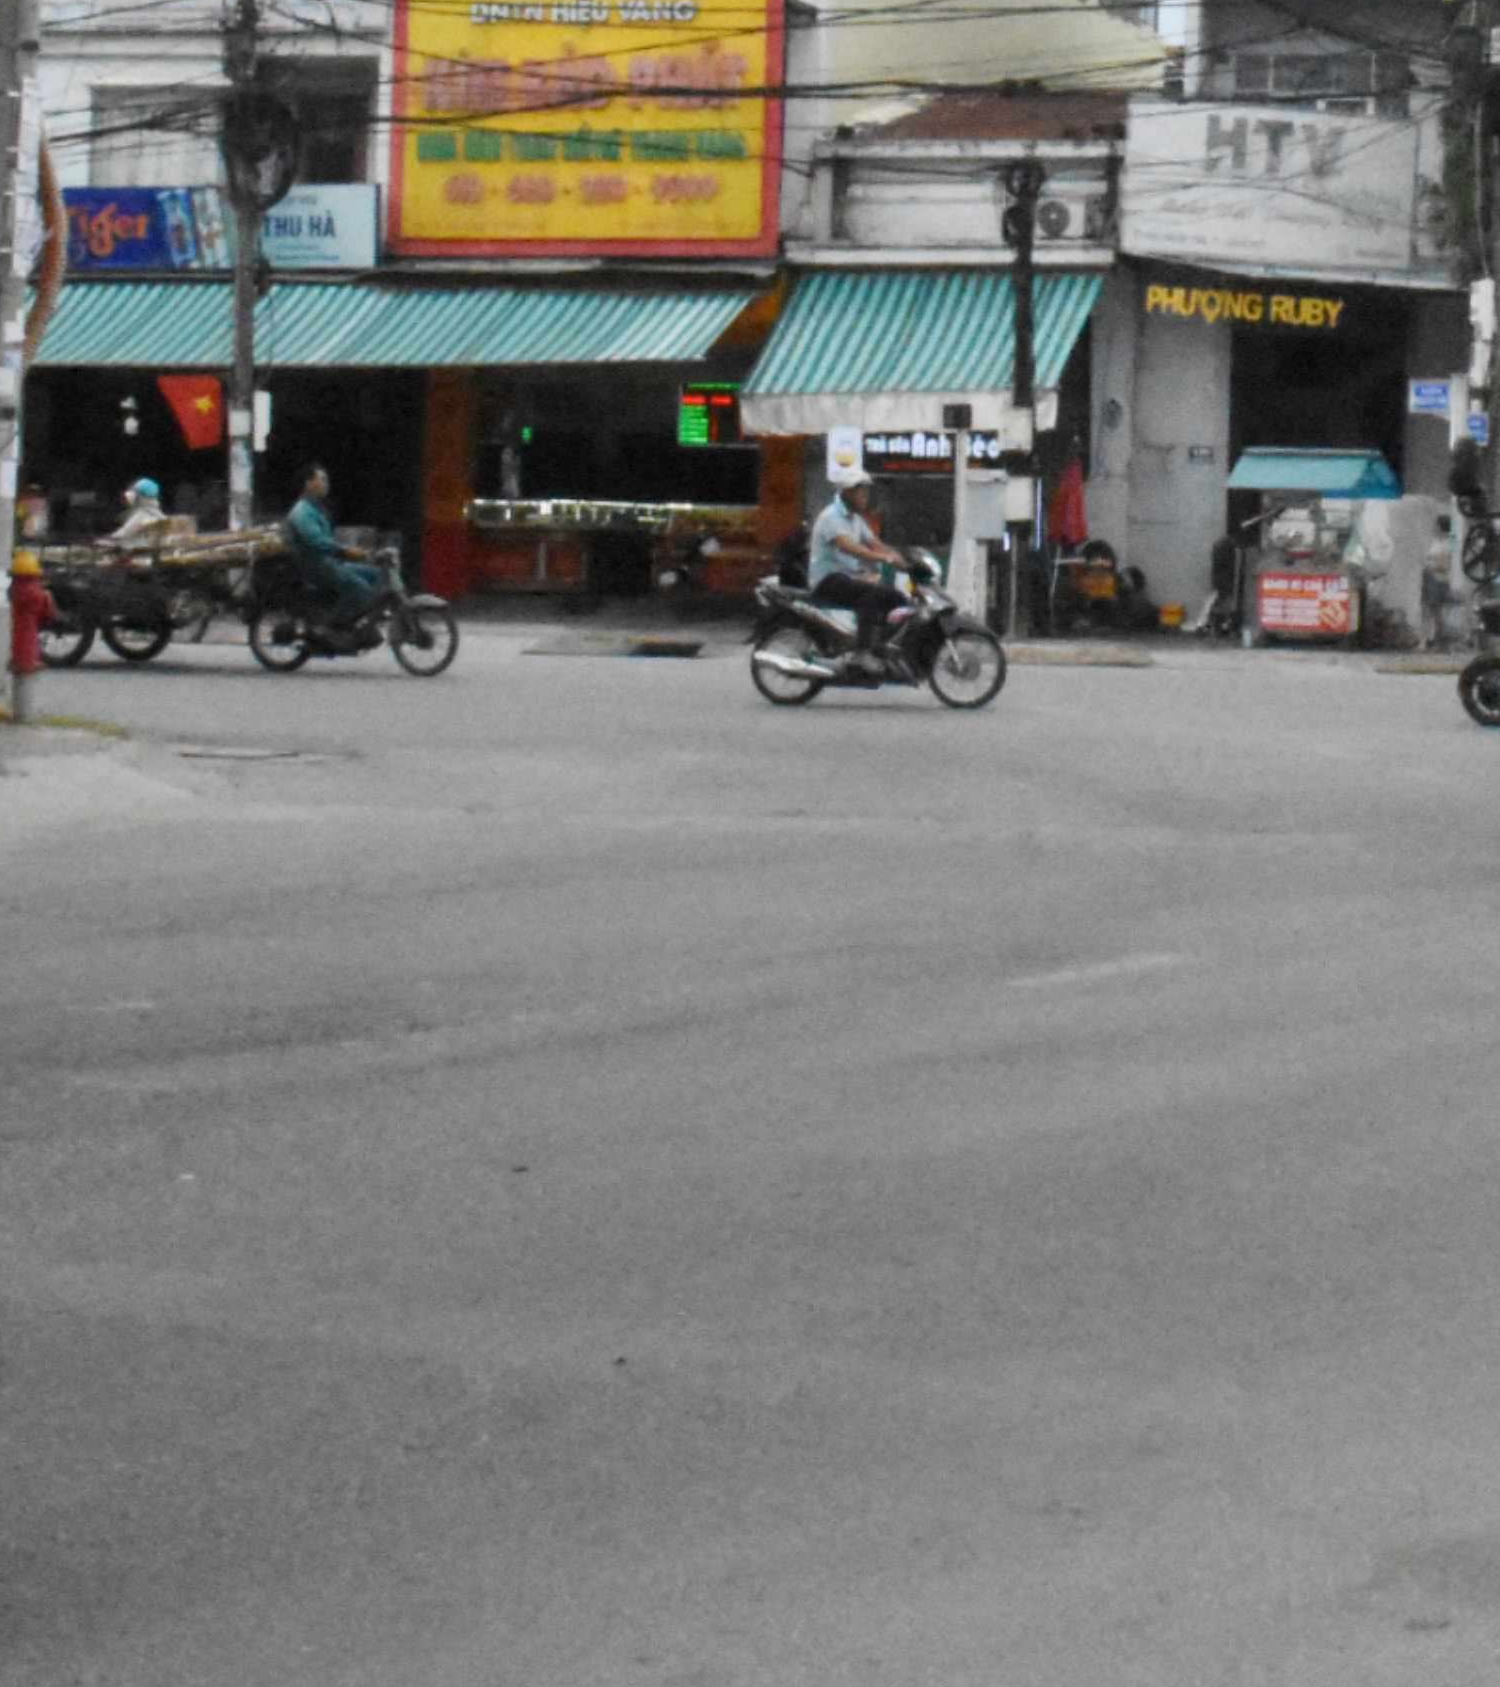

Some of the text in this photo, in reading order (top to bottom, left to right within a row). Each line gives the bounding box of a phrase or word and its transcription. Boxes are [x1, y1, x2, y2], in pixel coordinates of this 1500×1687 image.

[263, 209, 337, 238] THU HÀ
[1269, 294, 1345, 328] RUBY
